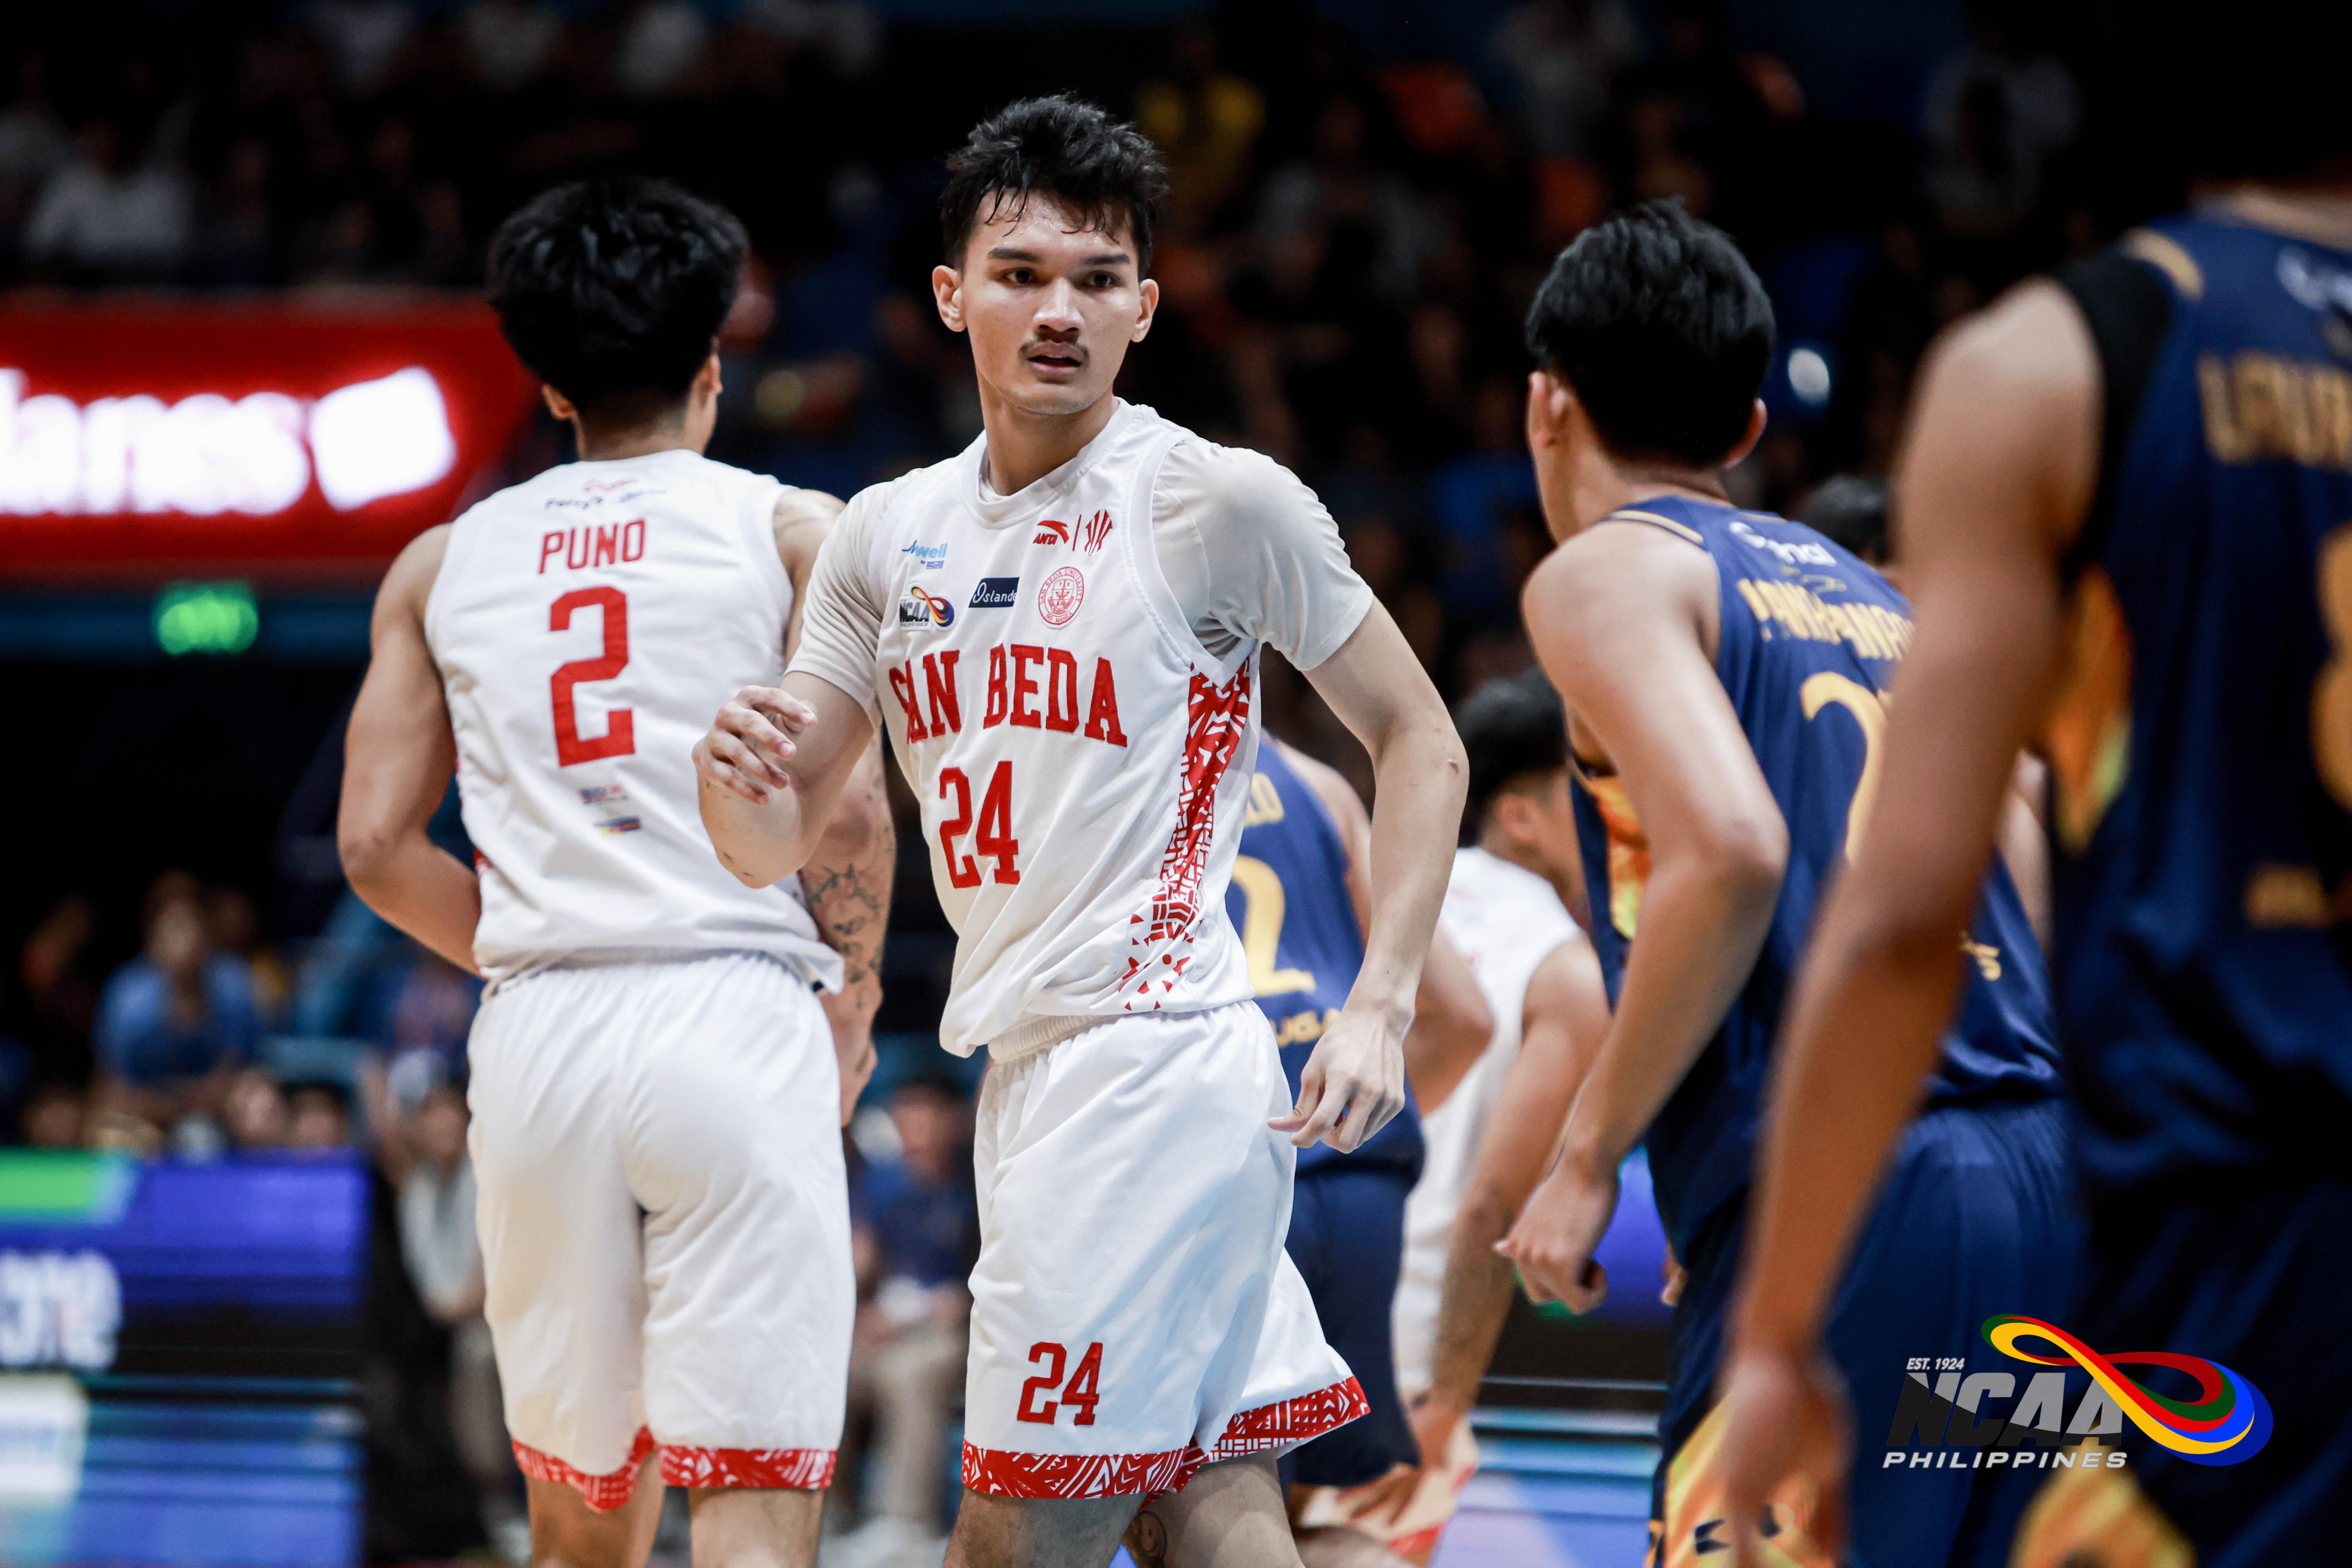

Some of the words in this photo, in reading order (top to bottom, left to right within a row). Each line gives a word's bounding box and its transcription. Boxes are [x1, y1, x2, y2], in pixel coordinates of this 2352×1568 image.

[539, 517, 646, 575] PUNO
[1033, 533, 1058, 545] ANTA
[900, 601, 930, 622] NCAA
[1045, 570, 1062, 587] BEDA
[1065, 568, 1083, 603] UNIVERSITY
[550, 586, 635, 767] 2
[983, 643, 1128, 748] BEDA
[939, 760, 1020, 889] 24
[1016, 1342, 1103, 1426] 24
